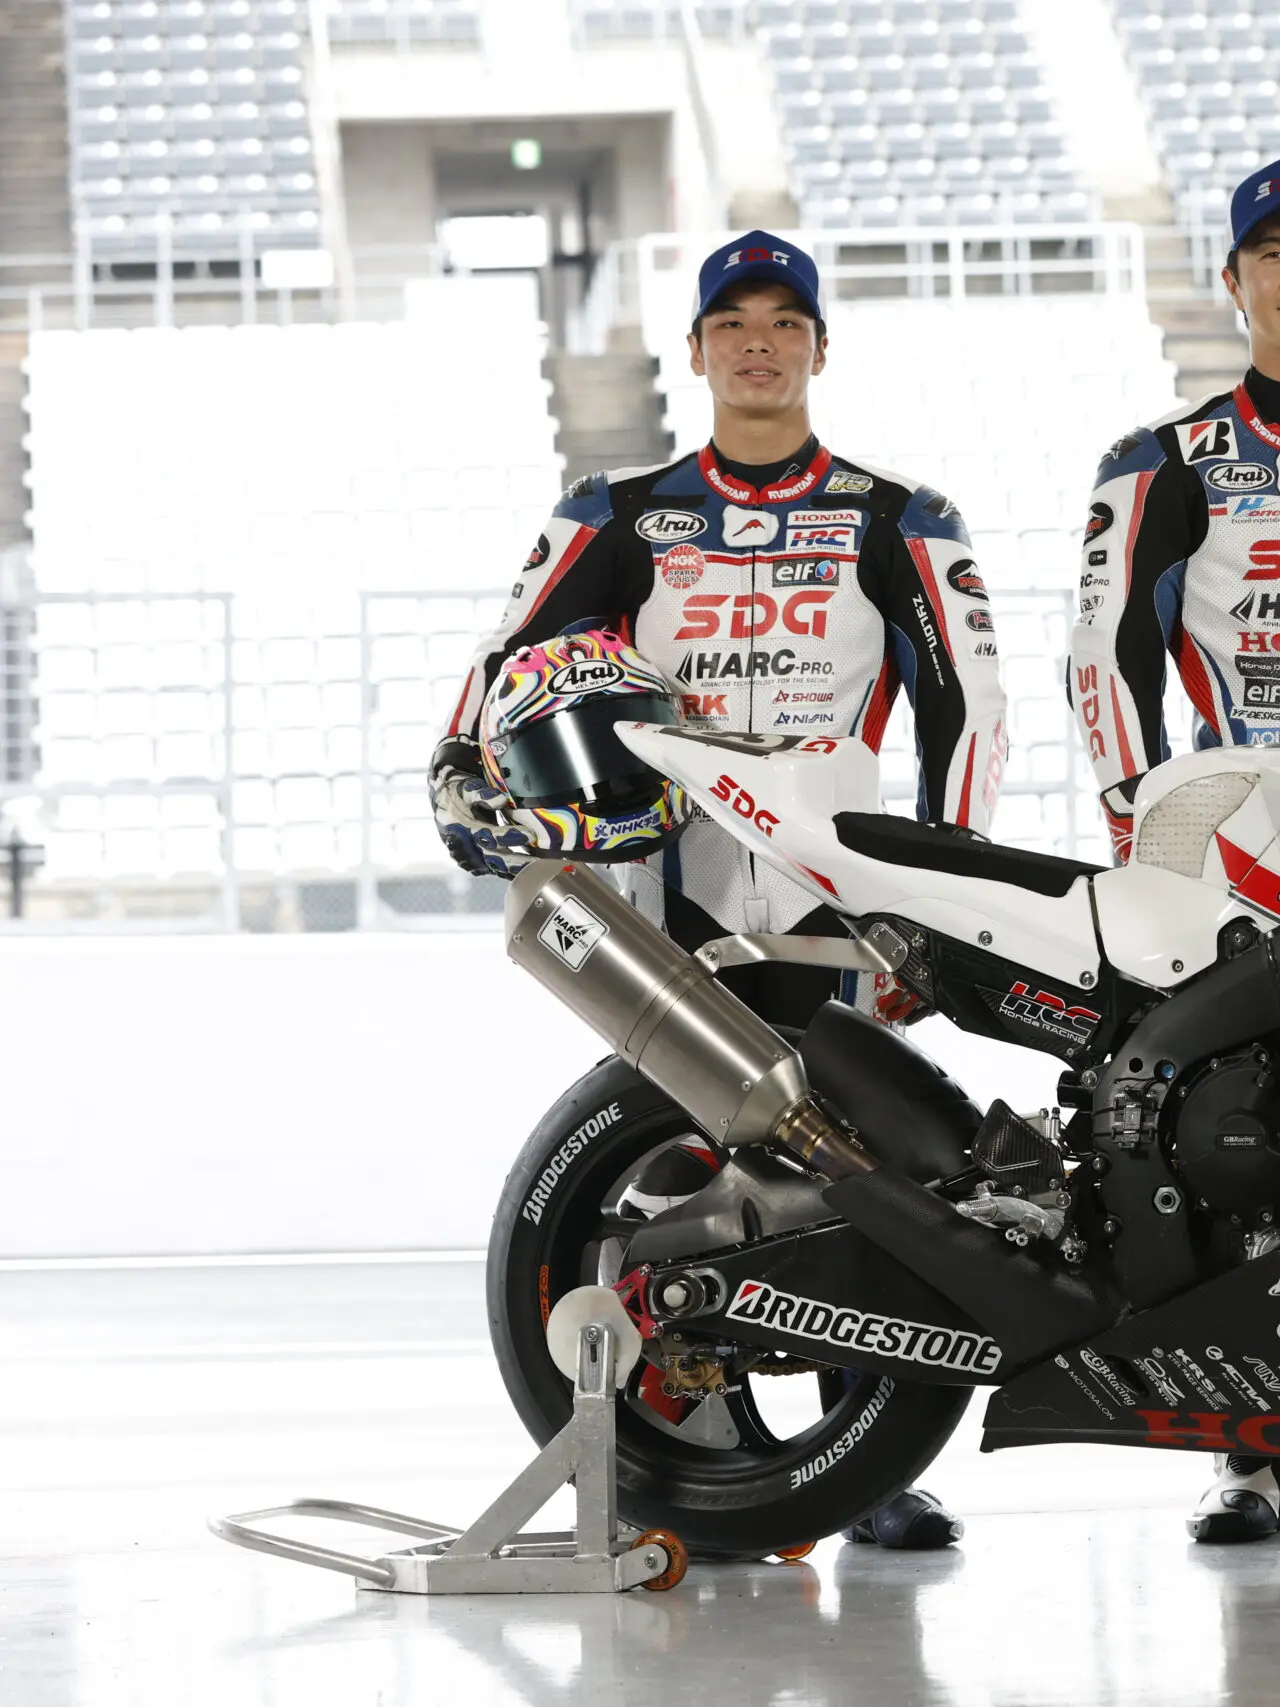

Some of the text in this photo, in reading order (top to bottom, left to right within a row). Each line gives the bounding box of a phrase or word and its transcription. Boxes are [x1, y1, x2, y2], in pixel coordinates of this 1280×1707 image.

[722, 247, 791, 270] SDG
[1214, 467, 1264, 483] Arai
[649, 514, 701, 533] Arai
[793, 512, 857, 522] HONDA
[789, 529, 852, 547] HRC
[667, 555, 698, 567] NGK
[776, 560, 815, 582] elf
[673, 590, 836, 640] SDG
[551, 662, 617, 693] Arai
[1240, 662, 1272, 671] Honda
[574, 680, 608, 690] HELMET
[792, 692, 834, 702] SHOWA
[680, 693, 729, 716] RK
[1077, 664, 1106, 763] SDG
[709, 774, 780, 836] SDG
[554, 914, 584, 940] HARC
[1001, 981, 1102, 1039] HRC
[1042, 1024, 1086, 1045] RACING
[1223, 1135, 1256, 1143] GBRacing
[522, 1101, 624, 1226] BRIDGESTONE
[725, 1279, 1002, 1375] BRIDGESTONE
[1088, 1353, 1137, 1407] GBRacing
[1132, 1358, 1178, 1407] MOTORBIKE
[1174, 1348, 1218, 1393] KRS
[1067, 1370, 1116, 1421] MOTOSALON
[1182, 1368, 1199, 1387] RACE
[1194, 1384, 1220, 1412] SERVICE
[1219, 1362, 1272, 1412] ACTIVE
[790, 1375, 896, 1490] BRIDGESTONE
